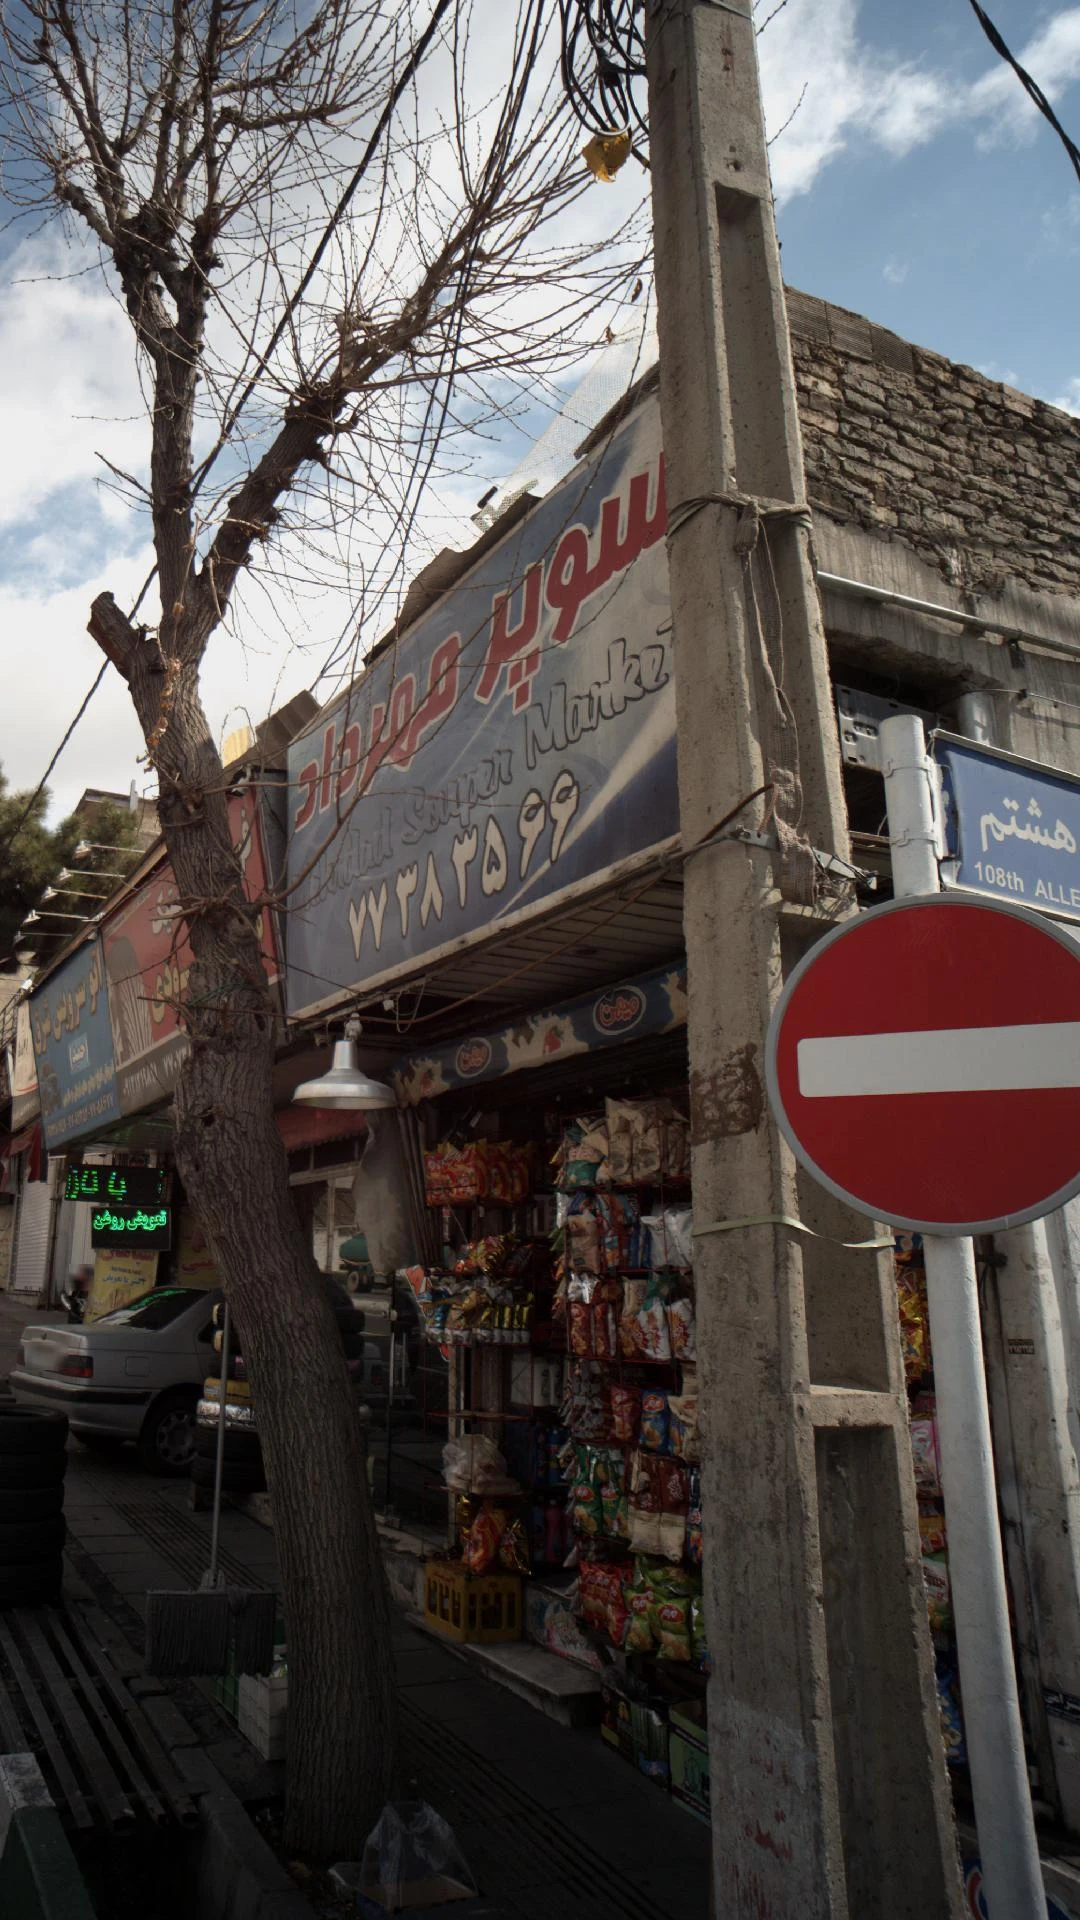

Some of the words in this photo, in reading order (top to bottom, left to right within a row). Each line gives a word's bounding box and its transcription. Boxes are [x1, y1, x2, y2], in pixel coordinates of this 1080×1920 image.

[475, 452, 668, 714] سوپر
[294, 632, 461, 833] مهرداد
[524, 619, 672, 771] Marke
[348, 769, 579, 961] ۷۷۳۸۳۵۶۶
[974, 861, 1024, 893] 108th
[980, 797, 1077, 854] هشتم
[93, 1209, 125, 1231] روغن
[126, 1209, 167, 1231] تعویض
